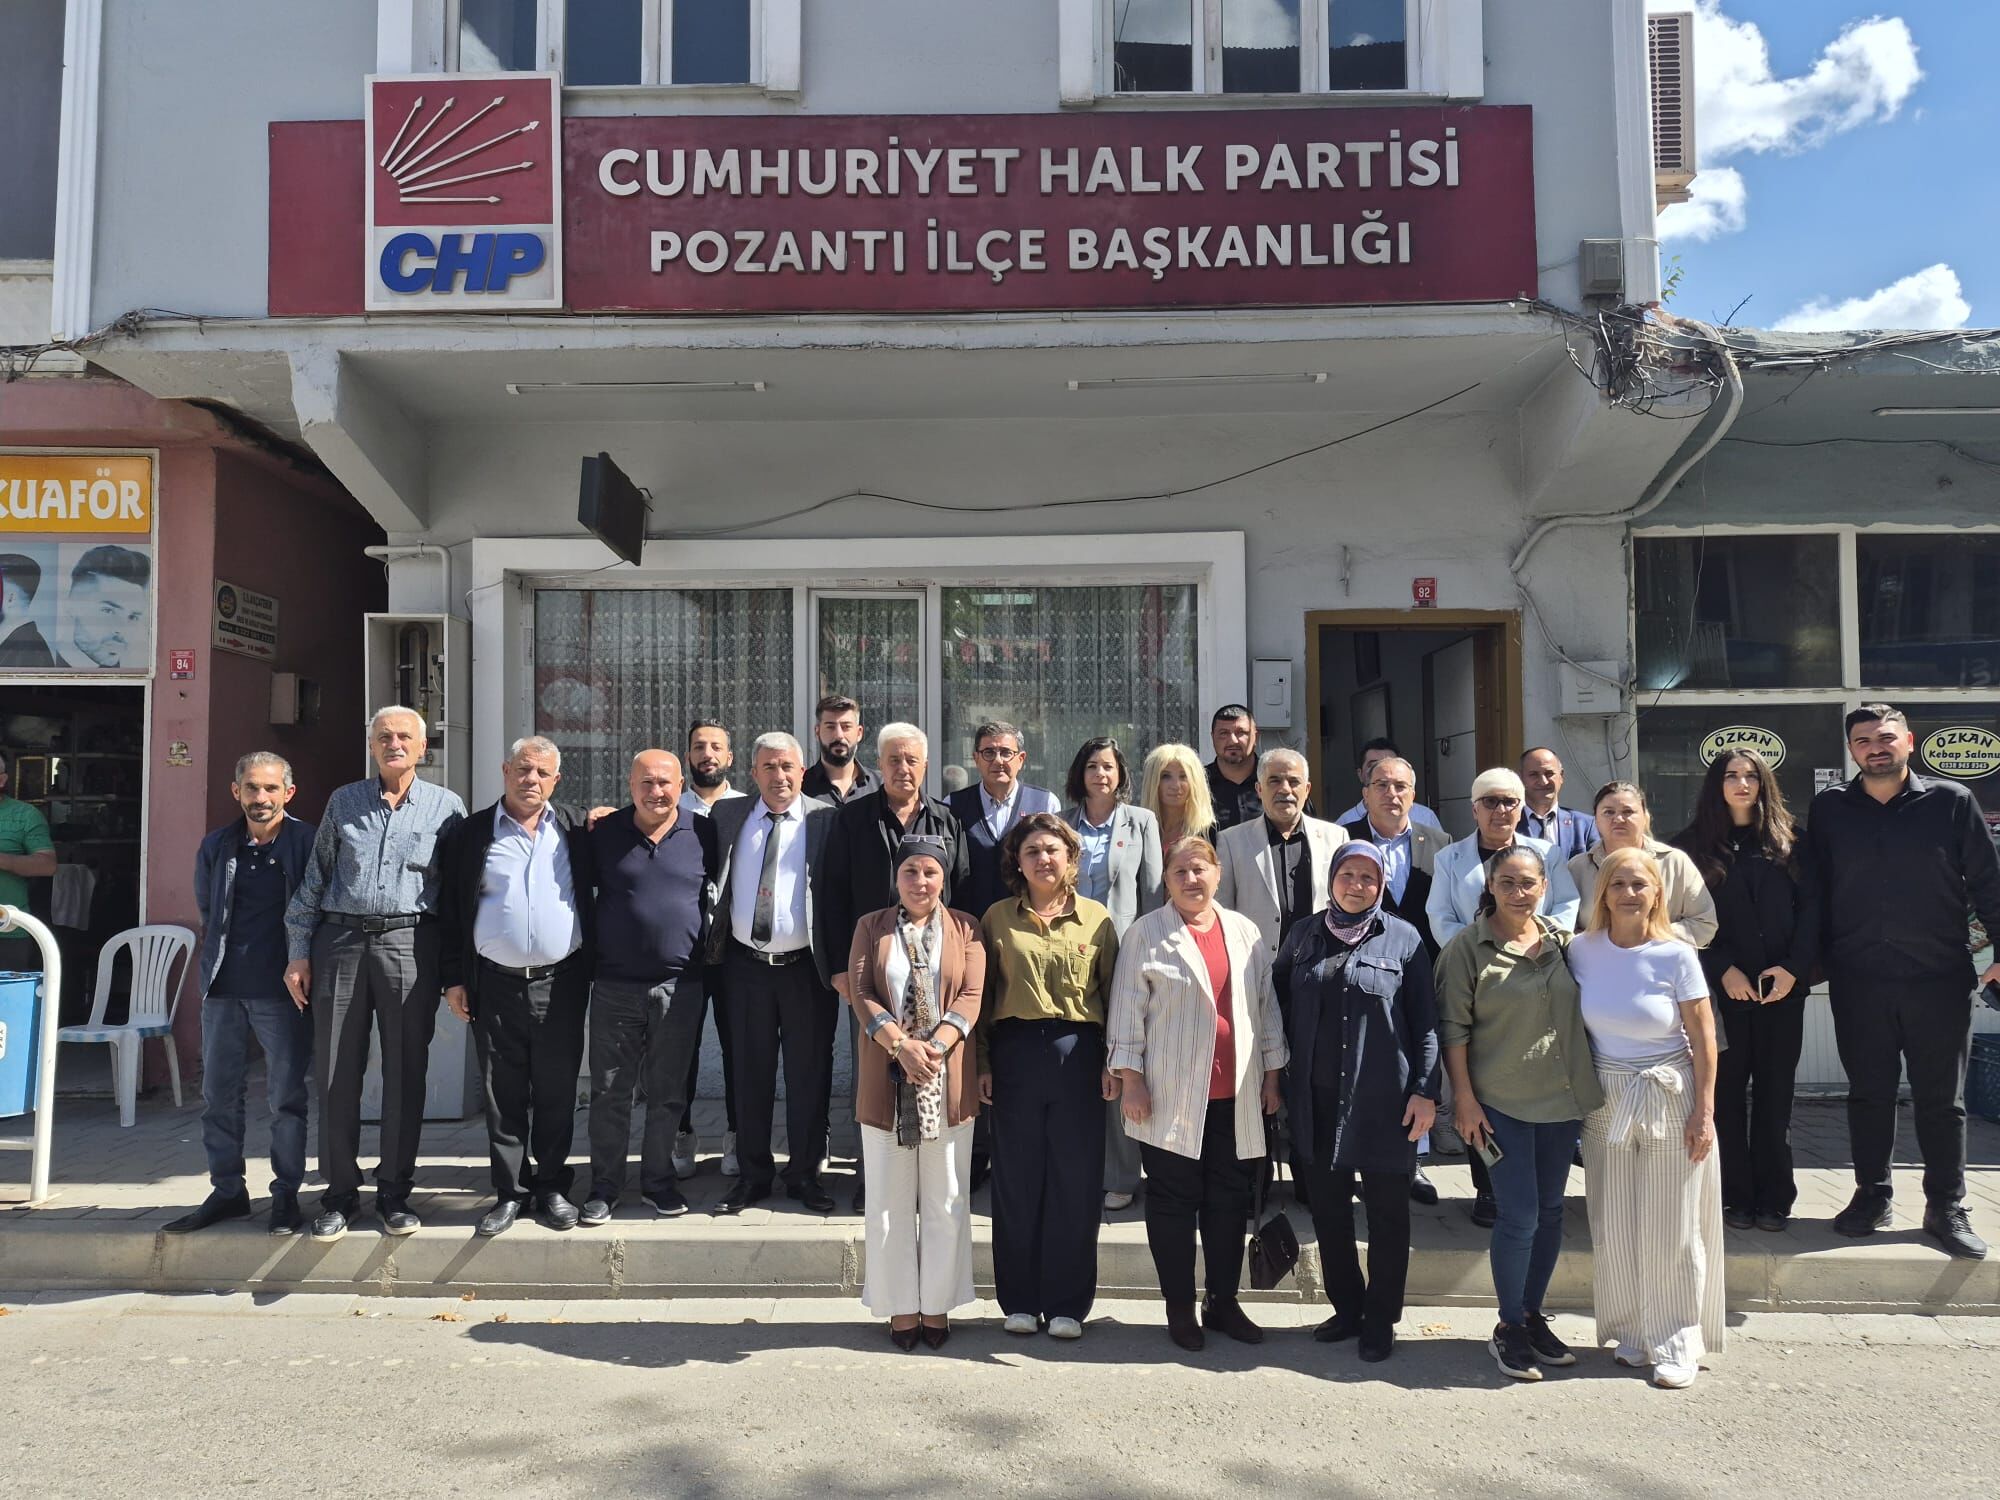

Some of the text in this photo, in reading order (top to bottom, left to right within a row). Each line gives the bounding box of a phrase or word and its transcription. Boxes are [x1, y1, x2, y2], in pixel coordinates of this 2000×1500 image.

[599, 127, 1460, 197] CUMHURİYET HALK PARTİSİ
[379, 232, 546, 294] CHP
[650, 209, 1411, 282] POZANTI İLÇE BAŞKANLIĞI
[1715, 731, 1772, 747] ÖZKAN
[1929, 749, 1961, 760] Kebap
[1936, 732, 1993, 748] ÖZKAN
